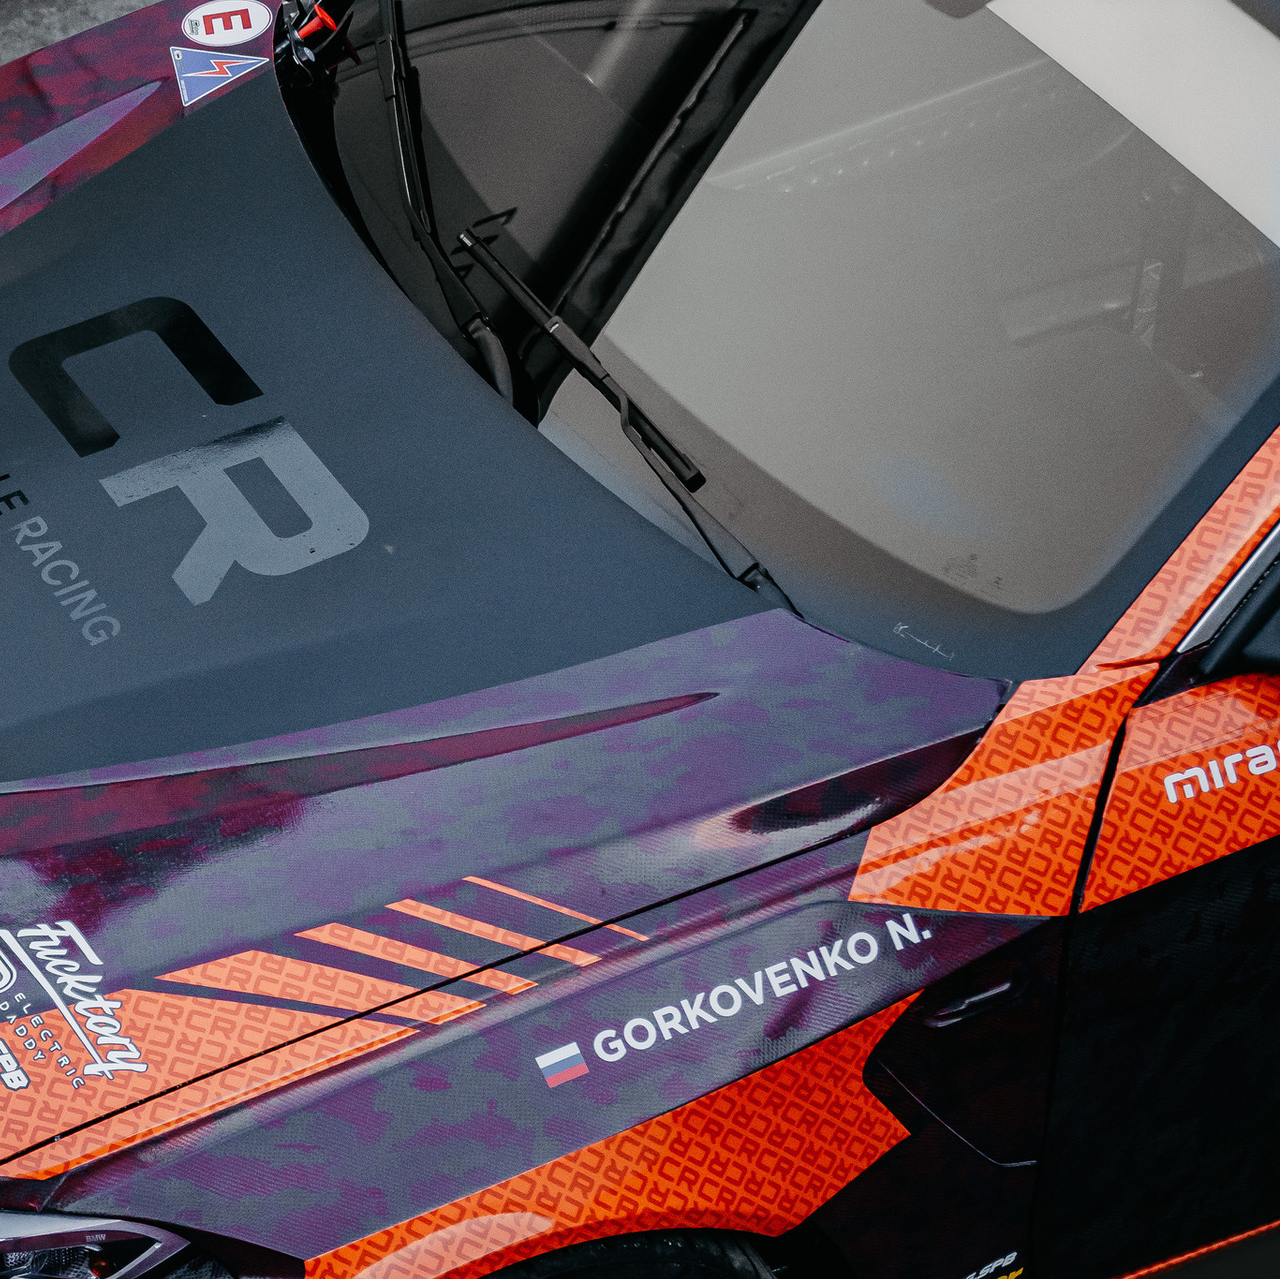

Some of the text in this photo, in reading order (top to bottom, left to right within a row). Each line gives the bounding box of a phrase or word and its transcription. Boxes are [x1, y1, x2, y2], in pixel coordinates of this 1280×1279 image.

[202, 8, 252, 35] E
[8, 296, 370, 606] CR
[7, 516, 121, 647] RACING
[1163, 739, 1280, 804] mira
[593, 912, 933, 1063] GORKOVENKO N.
[14, 992, 87, 1089] ELECTRIC
[85, 1233, 107, 1243] BMW
